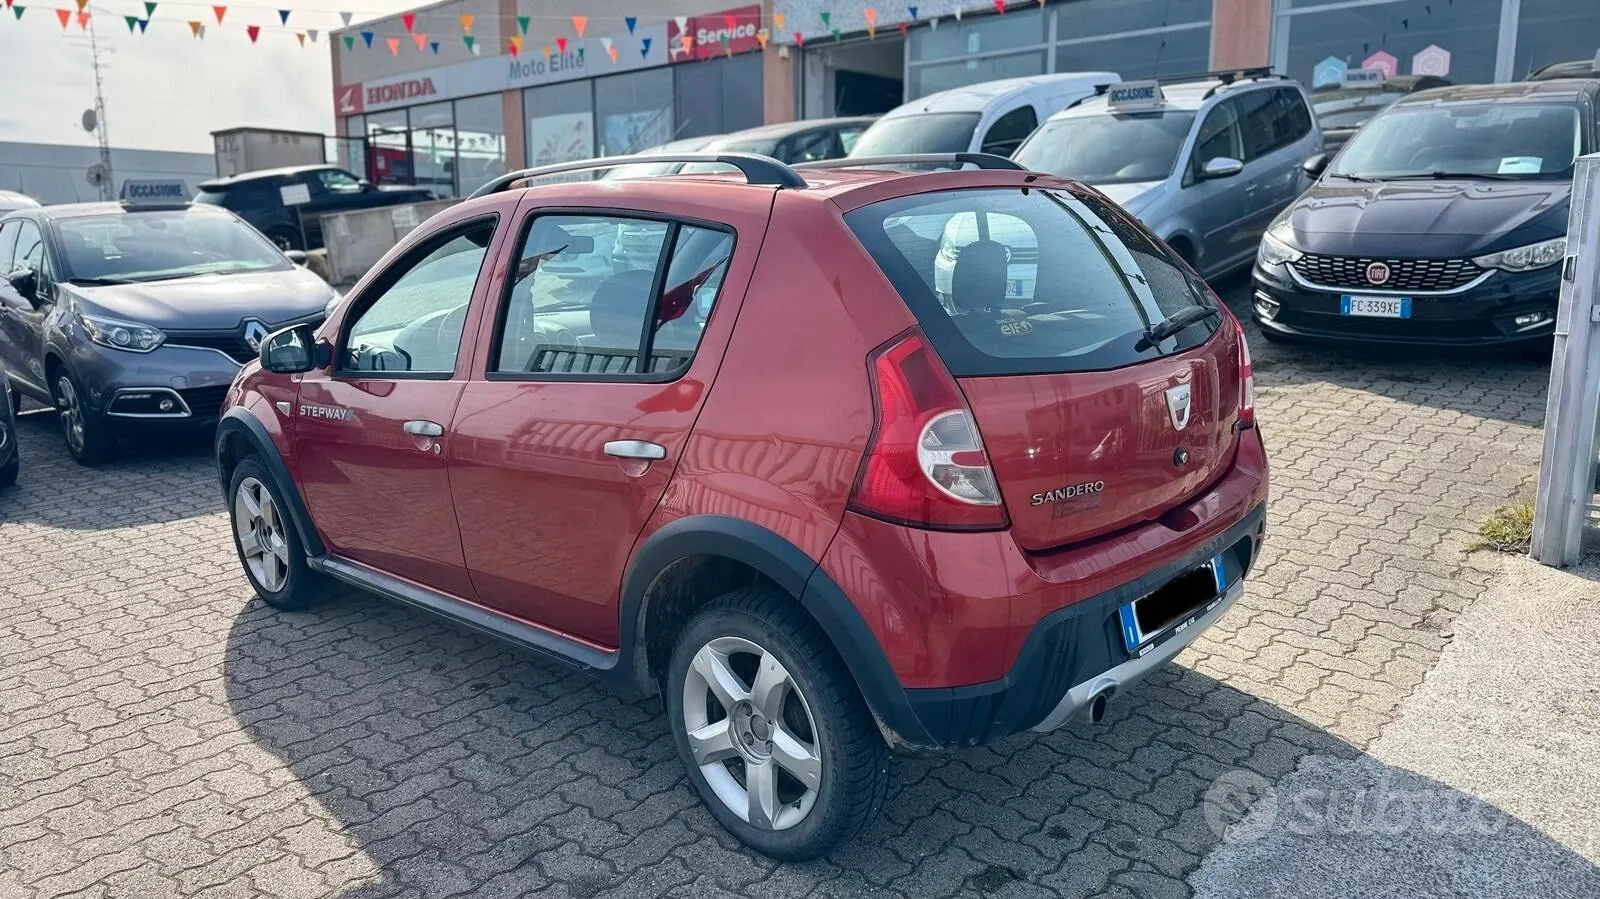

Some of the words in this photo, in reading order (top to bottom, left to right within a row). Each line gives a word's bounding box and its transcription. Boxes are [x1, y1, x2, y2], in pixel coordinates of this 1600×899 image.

[697, 23, 756, 45] Service
[509, 58, 545, 80] Moto
[366, 77, 437, 104] HONDA
[1111, 86, 1154, 102] OCCASIONE
[129, 184, 183, 198] OCCASIONE
[1371, 268, 1385, 280] FIAT
[300, 405, 347, 420] STEPWAY
[1030, 480, 1105, 506] SANDERO
